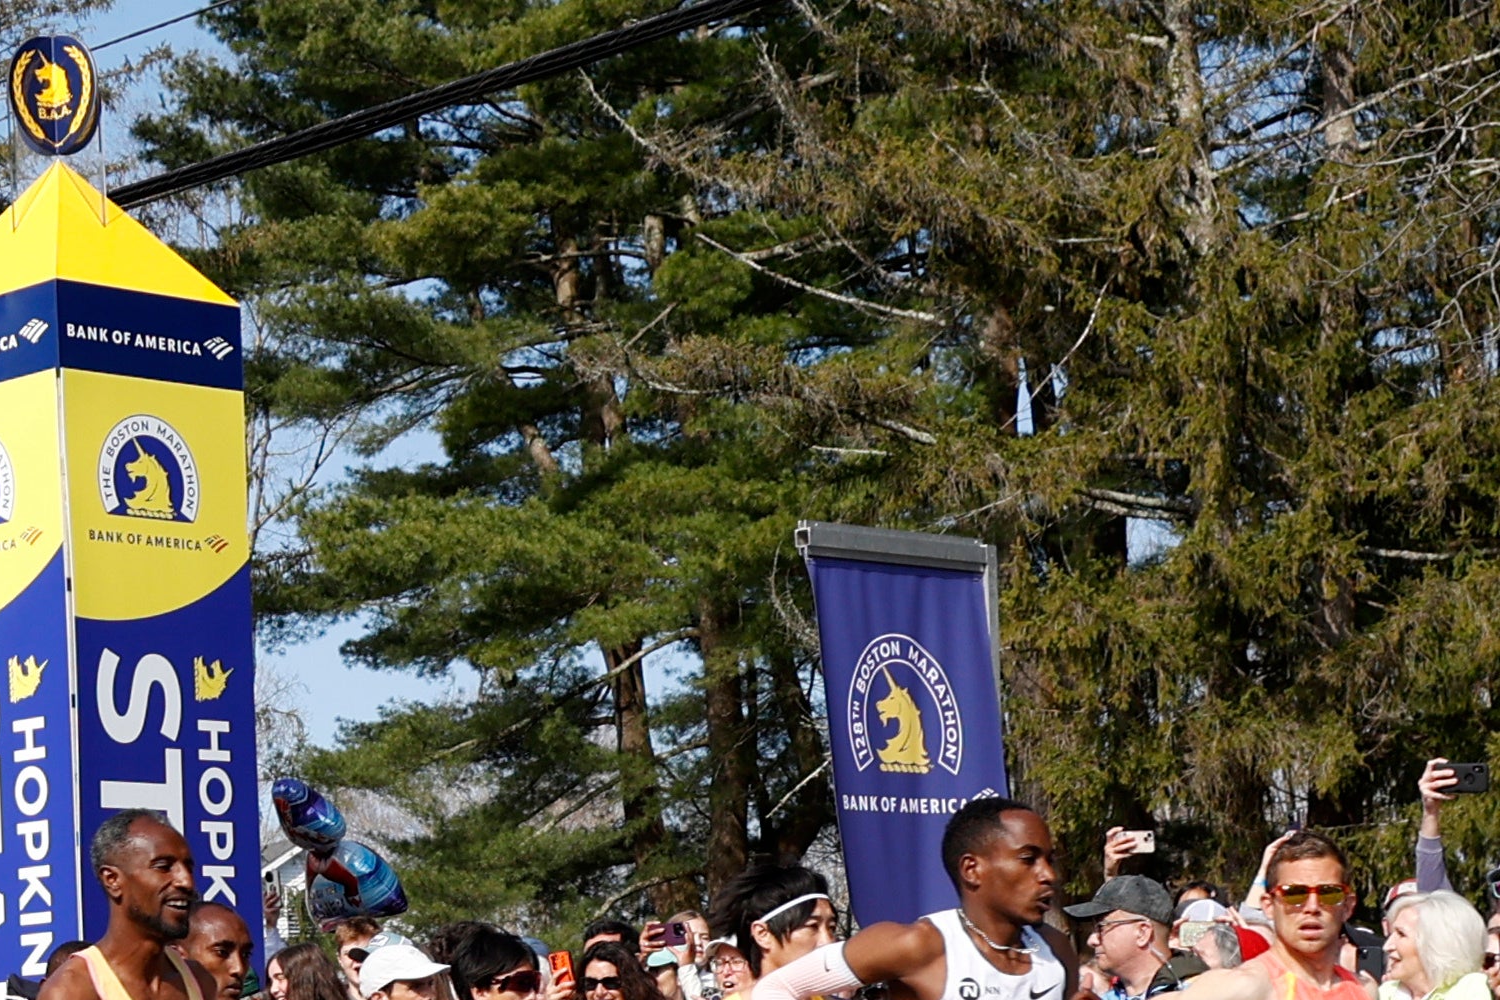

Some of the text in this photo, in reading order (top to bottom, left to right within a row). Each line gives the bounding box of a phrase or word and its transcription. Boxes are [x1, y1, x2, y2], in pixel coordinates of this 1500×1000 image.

[37, 105, 73, 120] B.A.A.
[66, 322, 202, 356] BANK OF AMERICA
[102, 420, 196, 511] THE BOSTON MARATHON
[88, 529, 203, 552] BANK OF AMERICA
[96, 647, 185, 838] ST
[852, 641, 958, 761] 128TH BOSTON MARATHON
[12, 715, 53, 977] HOPKIN
[197, 718, 238, 907] HOPK
[842, 794, 968, 814] BANK OF AMERICA
